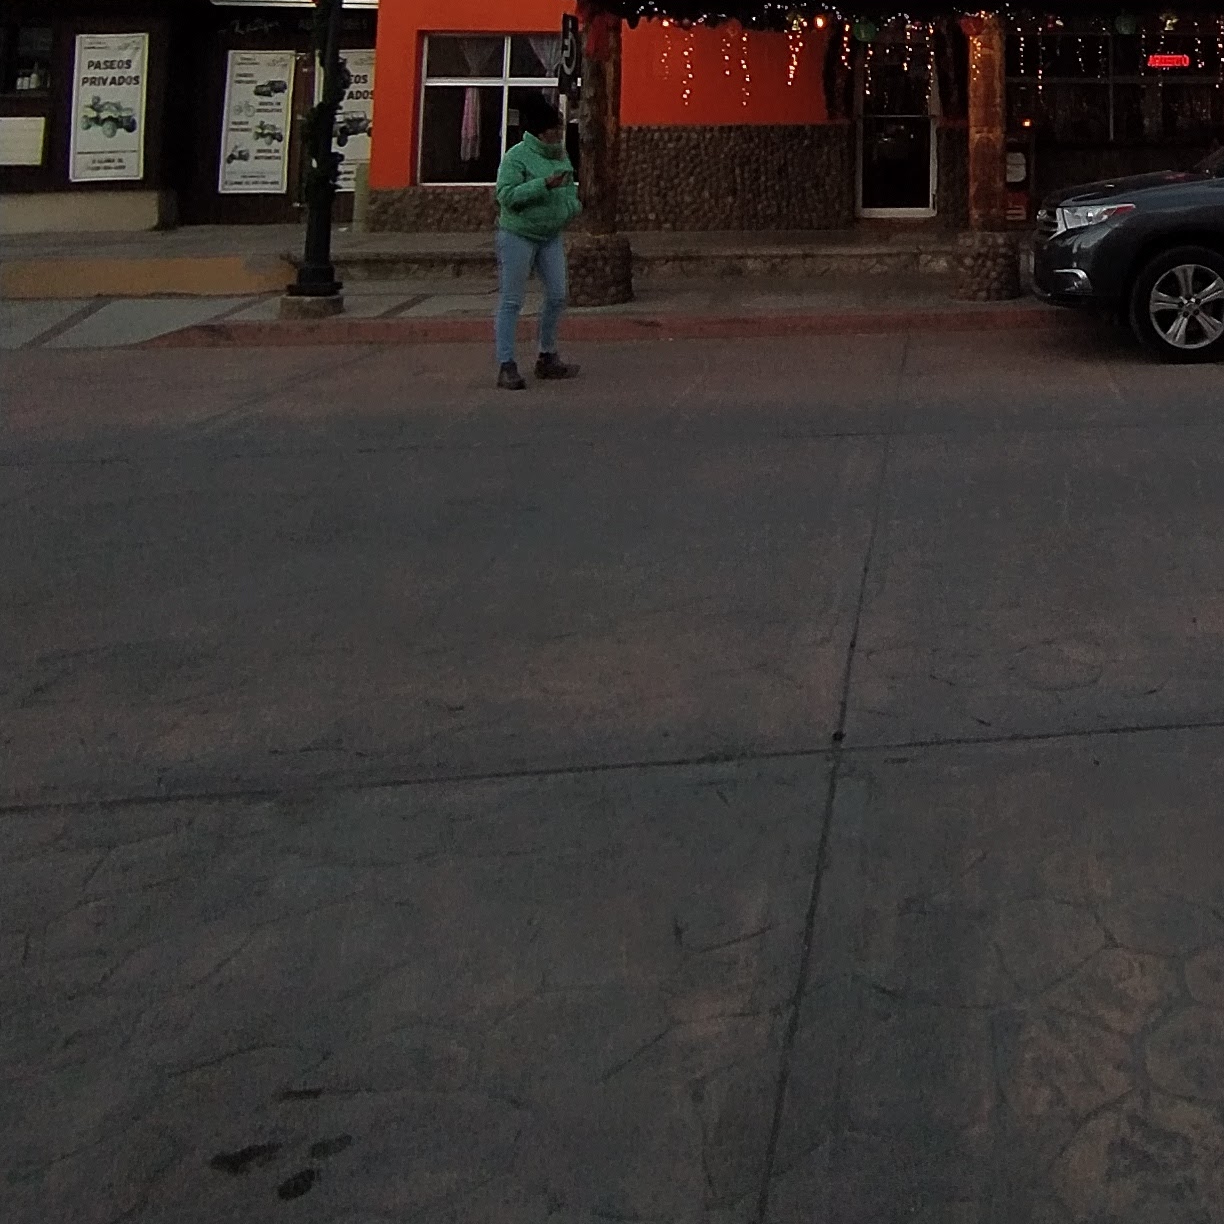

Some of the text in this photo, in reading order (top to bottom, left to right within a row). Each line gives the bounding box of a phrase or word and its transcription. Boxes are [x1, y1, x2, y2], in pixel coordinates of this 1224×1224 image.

[87, 59, 132, 70] PASEOS
[81, 75, 140, 87] PRIVADOS
[349, 74, 368, 84] EOS
[347, 90, 374, 100] ADOS
